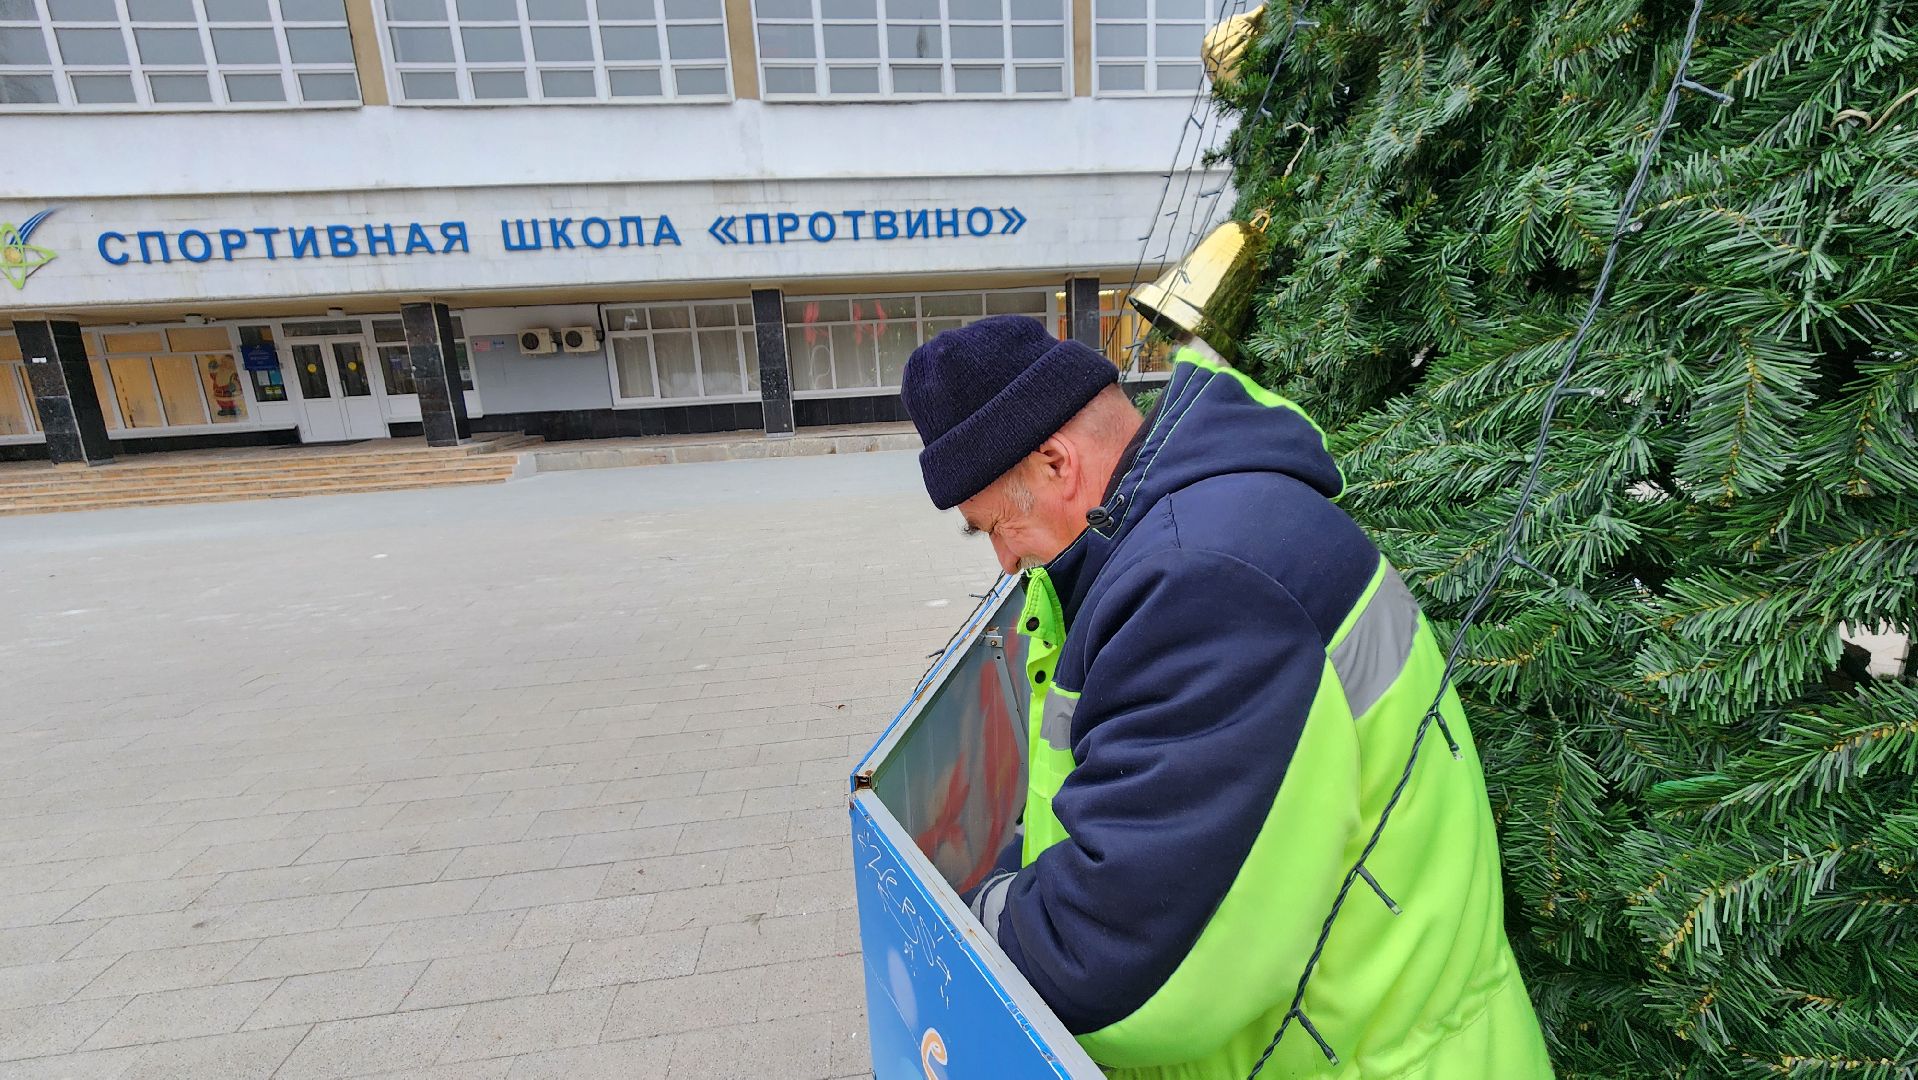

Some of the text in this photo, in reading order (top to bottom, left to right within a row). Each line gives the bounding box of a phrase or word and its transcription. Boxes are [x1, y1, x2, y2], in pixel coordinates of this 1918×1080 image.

[96, 206, 1028, 265] СПОРТИВНАЯ ШКОЛА «ПРОТВИНО»
